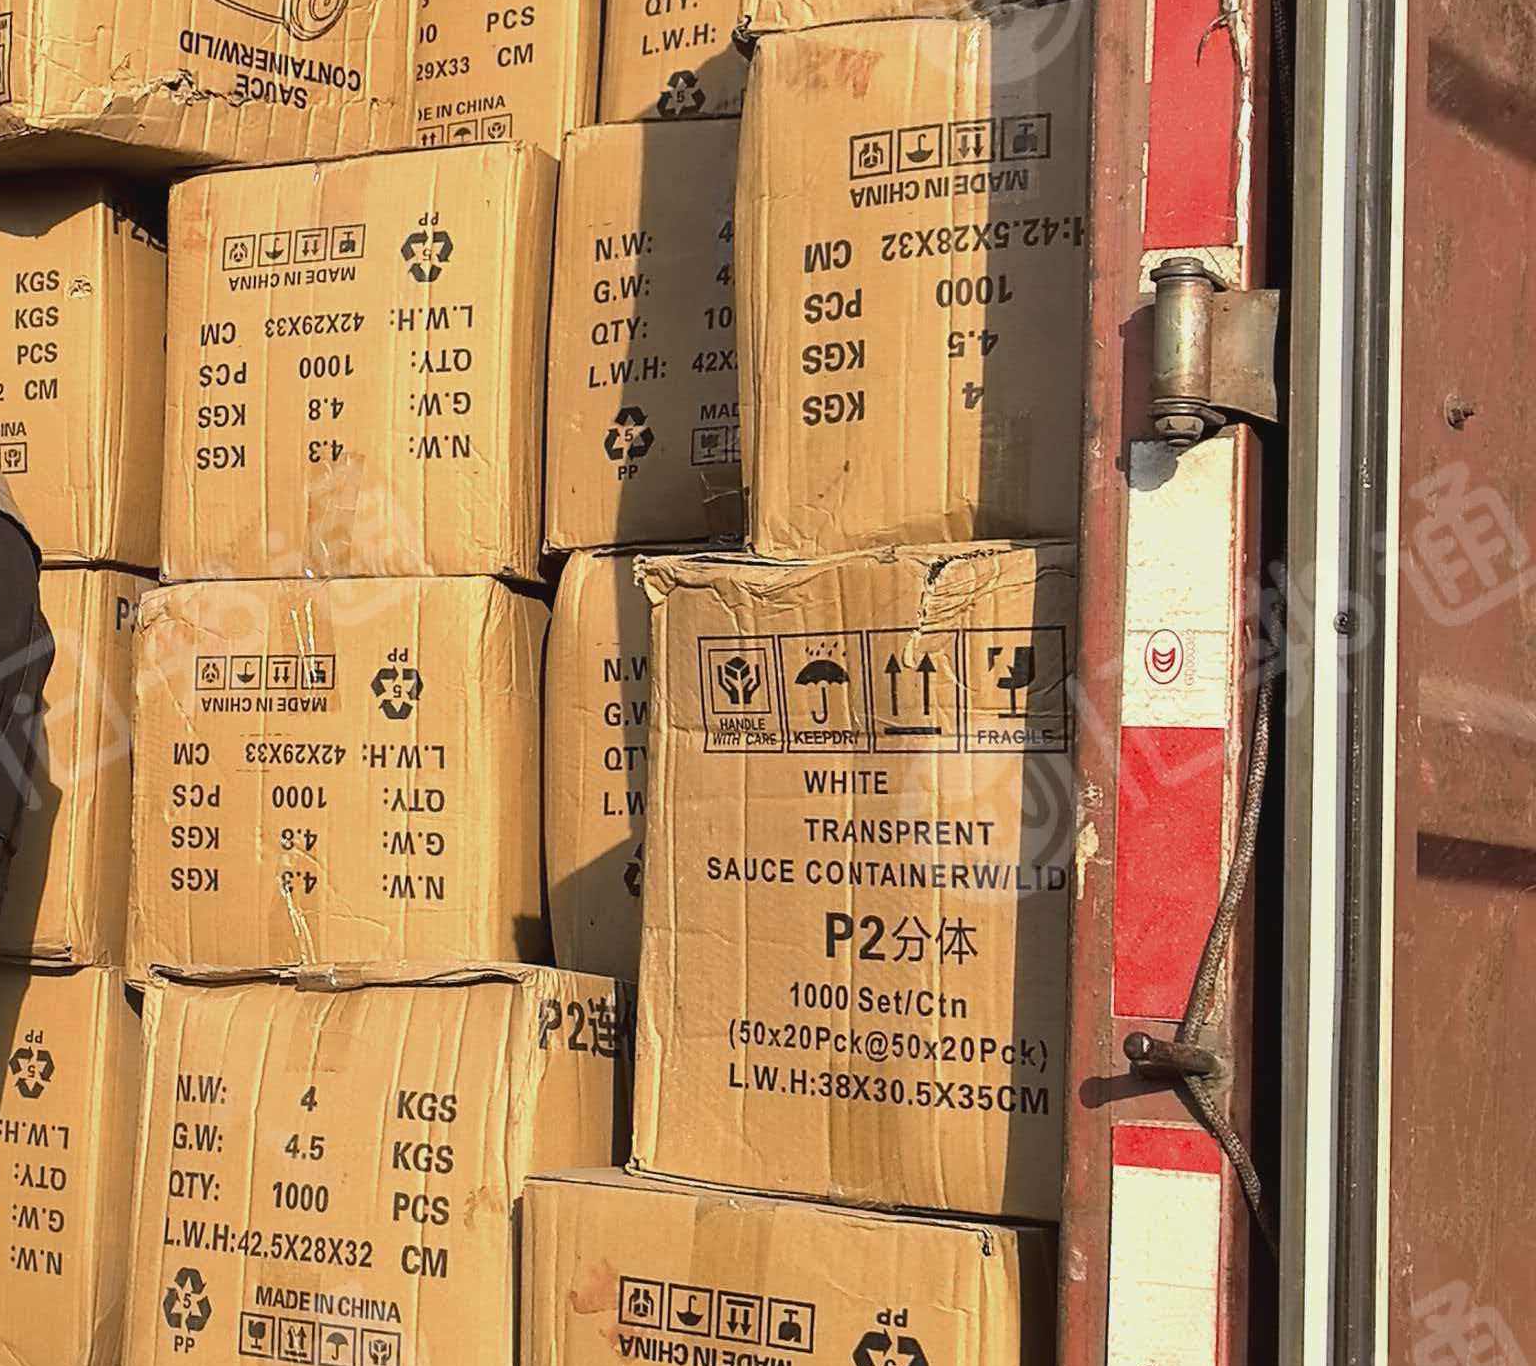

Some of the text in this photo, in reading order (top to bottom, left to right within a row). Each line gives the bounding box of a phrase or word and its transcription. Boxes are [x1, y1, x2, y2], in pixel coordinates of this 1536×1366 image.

[180, 30, 362, 93] CONTAINERW/LID
[235, 74, 308, 110] SAUCE
[803, 276, 1014, 325] 1000 PCS
[199, 305, 474, 345] L.W.H: 42X29X33 CM
[198, 349, 473, 386] QTY: 1000 PCS
[802, 331, 1000, 374] 4.5 KGS
[803, 382, 986, 427] 4 KGS
[197, 434, 472, 468] N.W: 4.3 KGS
[712, 732, 778, 746] WITH CARE
[719, 717, 765, 732] HANDLE
[793, 730, 860, 746] KEEPDRY
[977, 729, 1055, 745] FRAGILE
[804, 771, 889, 796] WHITE
[804, 818, 995, 846] TRANSPRENT
[706, 858, 1067, 891] SAUCE CONTAINERW/LID
[824, 913, 978, 965] P2分体
[789, 982, 968, 1020] 1000 Set/Ctn
[728, 1019, 1049, 1073] (50x20Pck@50x20Pck)
[175, 1074, 458, 1123] N.W: 4 KGS
[728, 1066, 1050, 1115] L.W.H:38X30.5X35CM
[172, 1123, 454, 1174] G.W: 4.5 KGS
[168, 1170, 449, 1225] QTY: 1000 PCS
[164, 1217, 448, 1278] L.W.H:42.5X28X32 CM
[255, 1286, 401, 1323] MADE IN CHINA
[876, 1309, 908, 1328] PP
